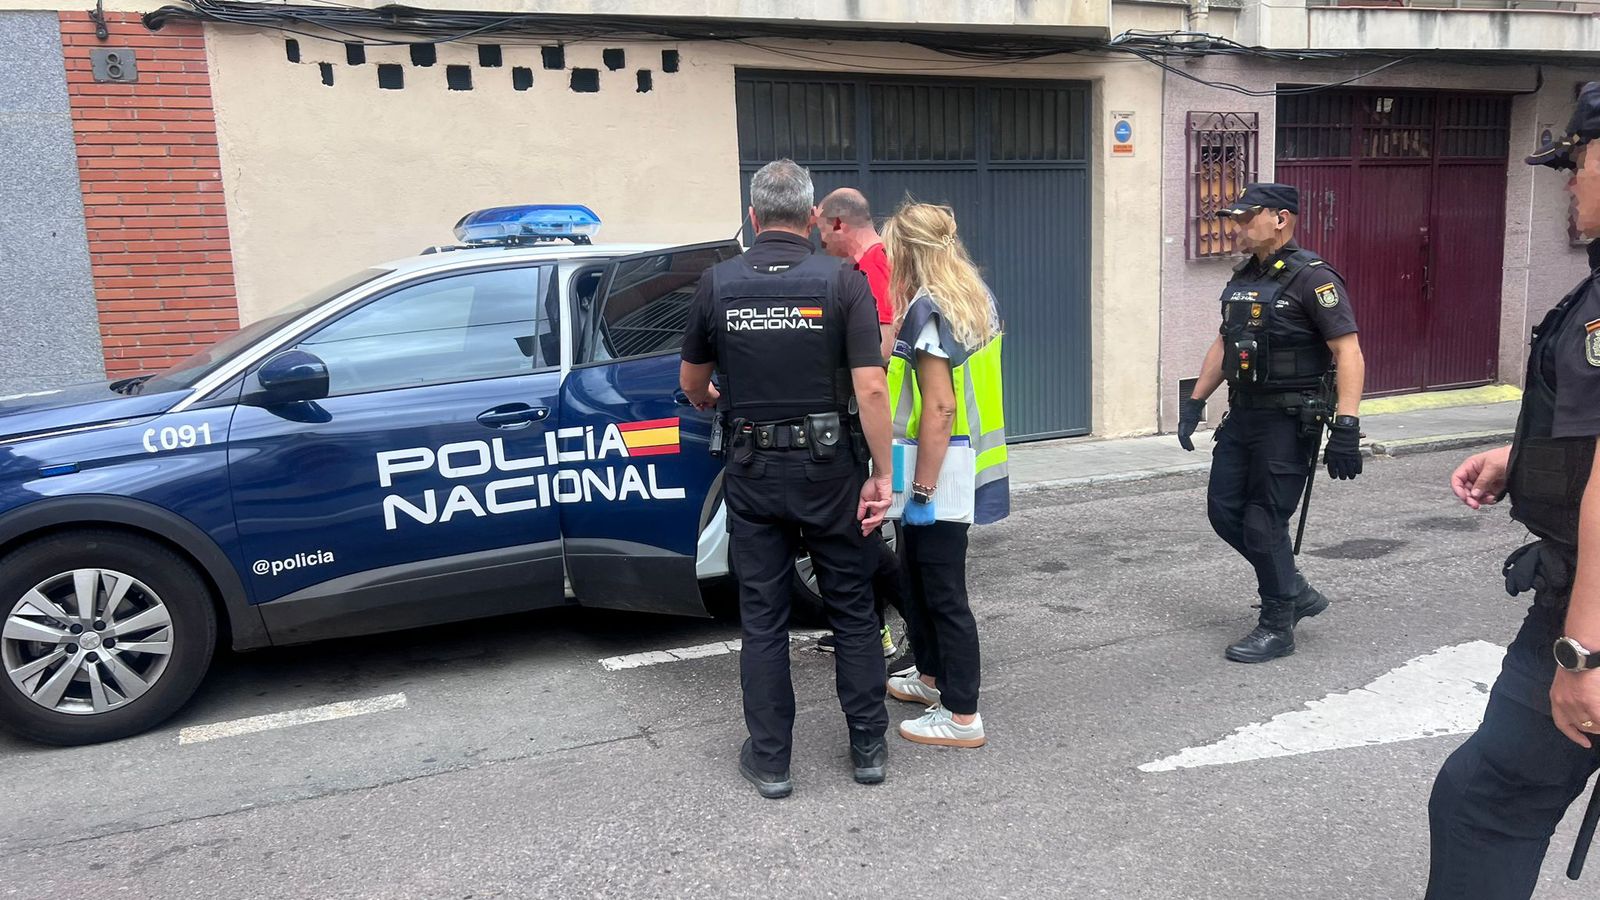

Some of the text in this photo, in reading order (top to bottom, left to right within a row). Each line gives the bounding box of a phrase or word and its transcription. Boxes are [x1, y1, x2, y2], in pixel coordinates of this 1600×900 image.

[105, 52, 123, 79] 8
[726, 307, 802, 320] POLICIA
[727, 319, 823, 331] NACIONAL
[160, 422, 212, 450] 091
[383, 464, 686, 530] NACIONAL
[252, 549, 335, 576] @policia
